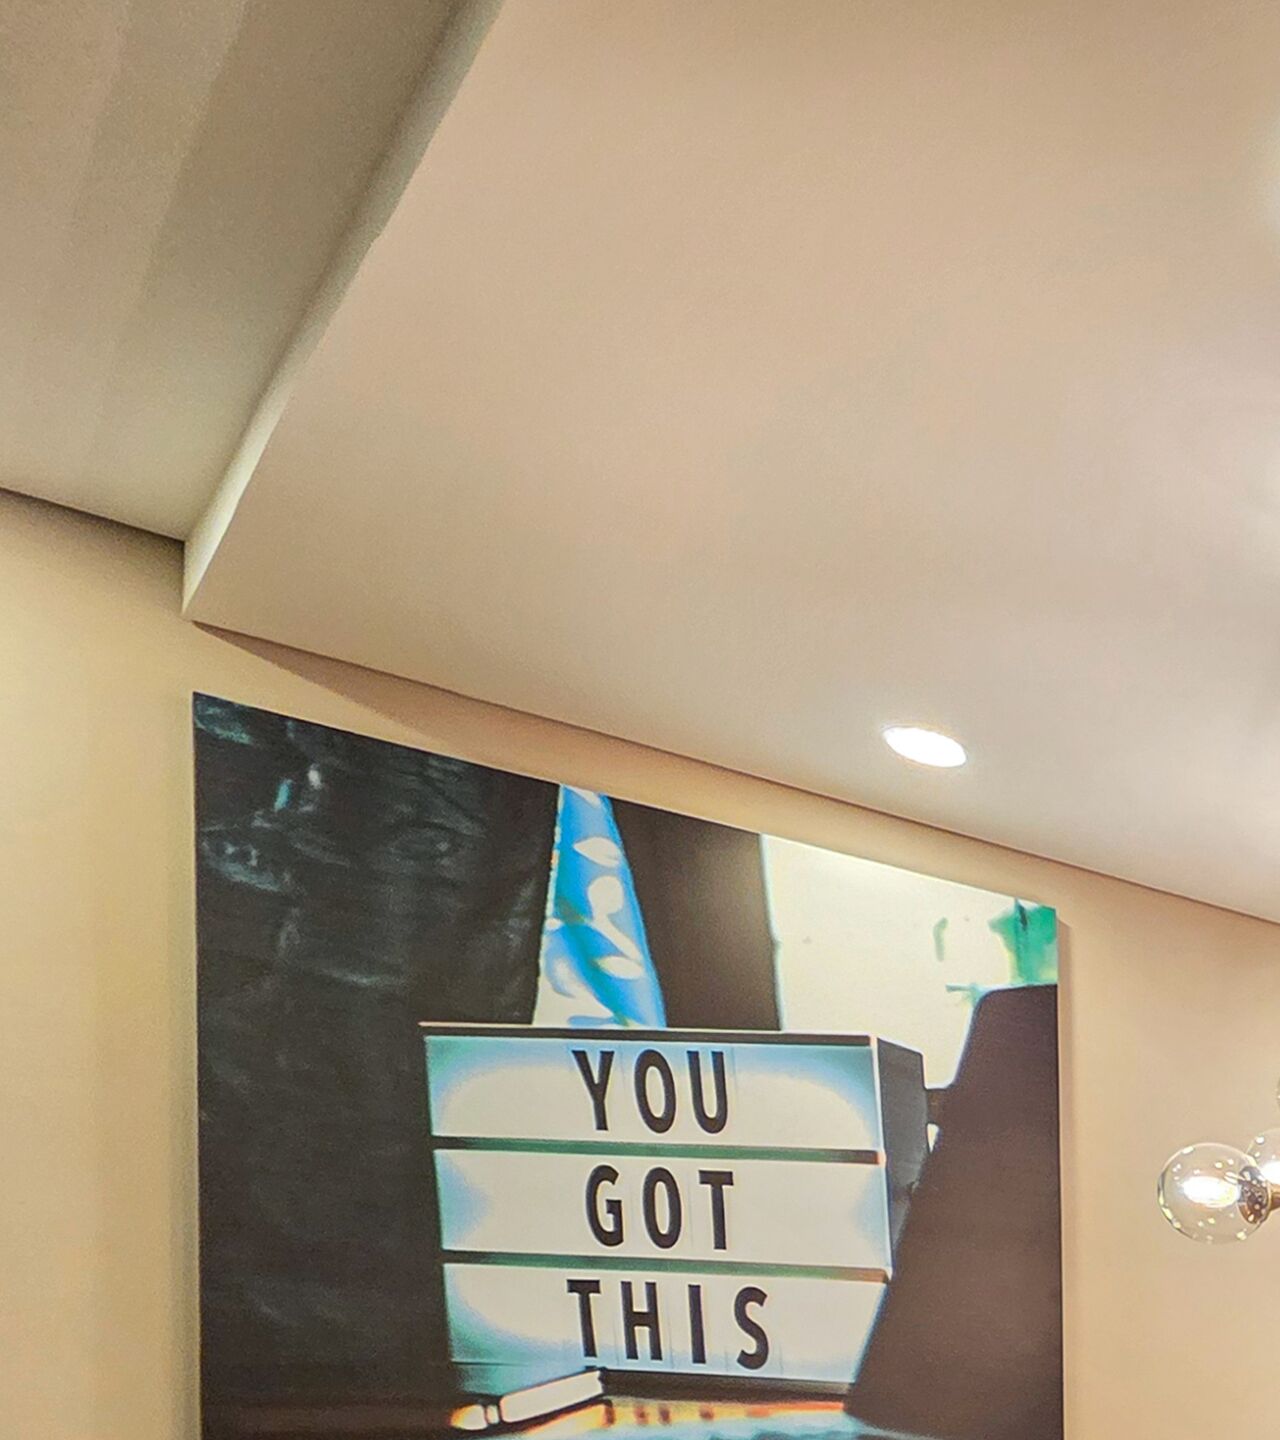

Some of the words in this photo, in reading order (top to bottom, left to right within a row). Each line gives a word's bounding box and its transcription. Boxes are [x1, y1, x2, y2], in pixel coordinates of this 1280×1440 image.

[571, 1048, 729, 1135] YOU
[585, 1164, 735, 1250] GOT
[566, 1278, 770, 1370] THIS
